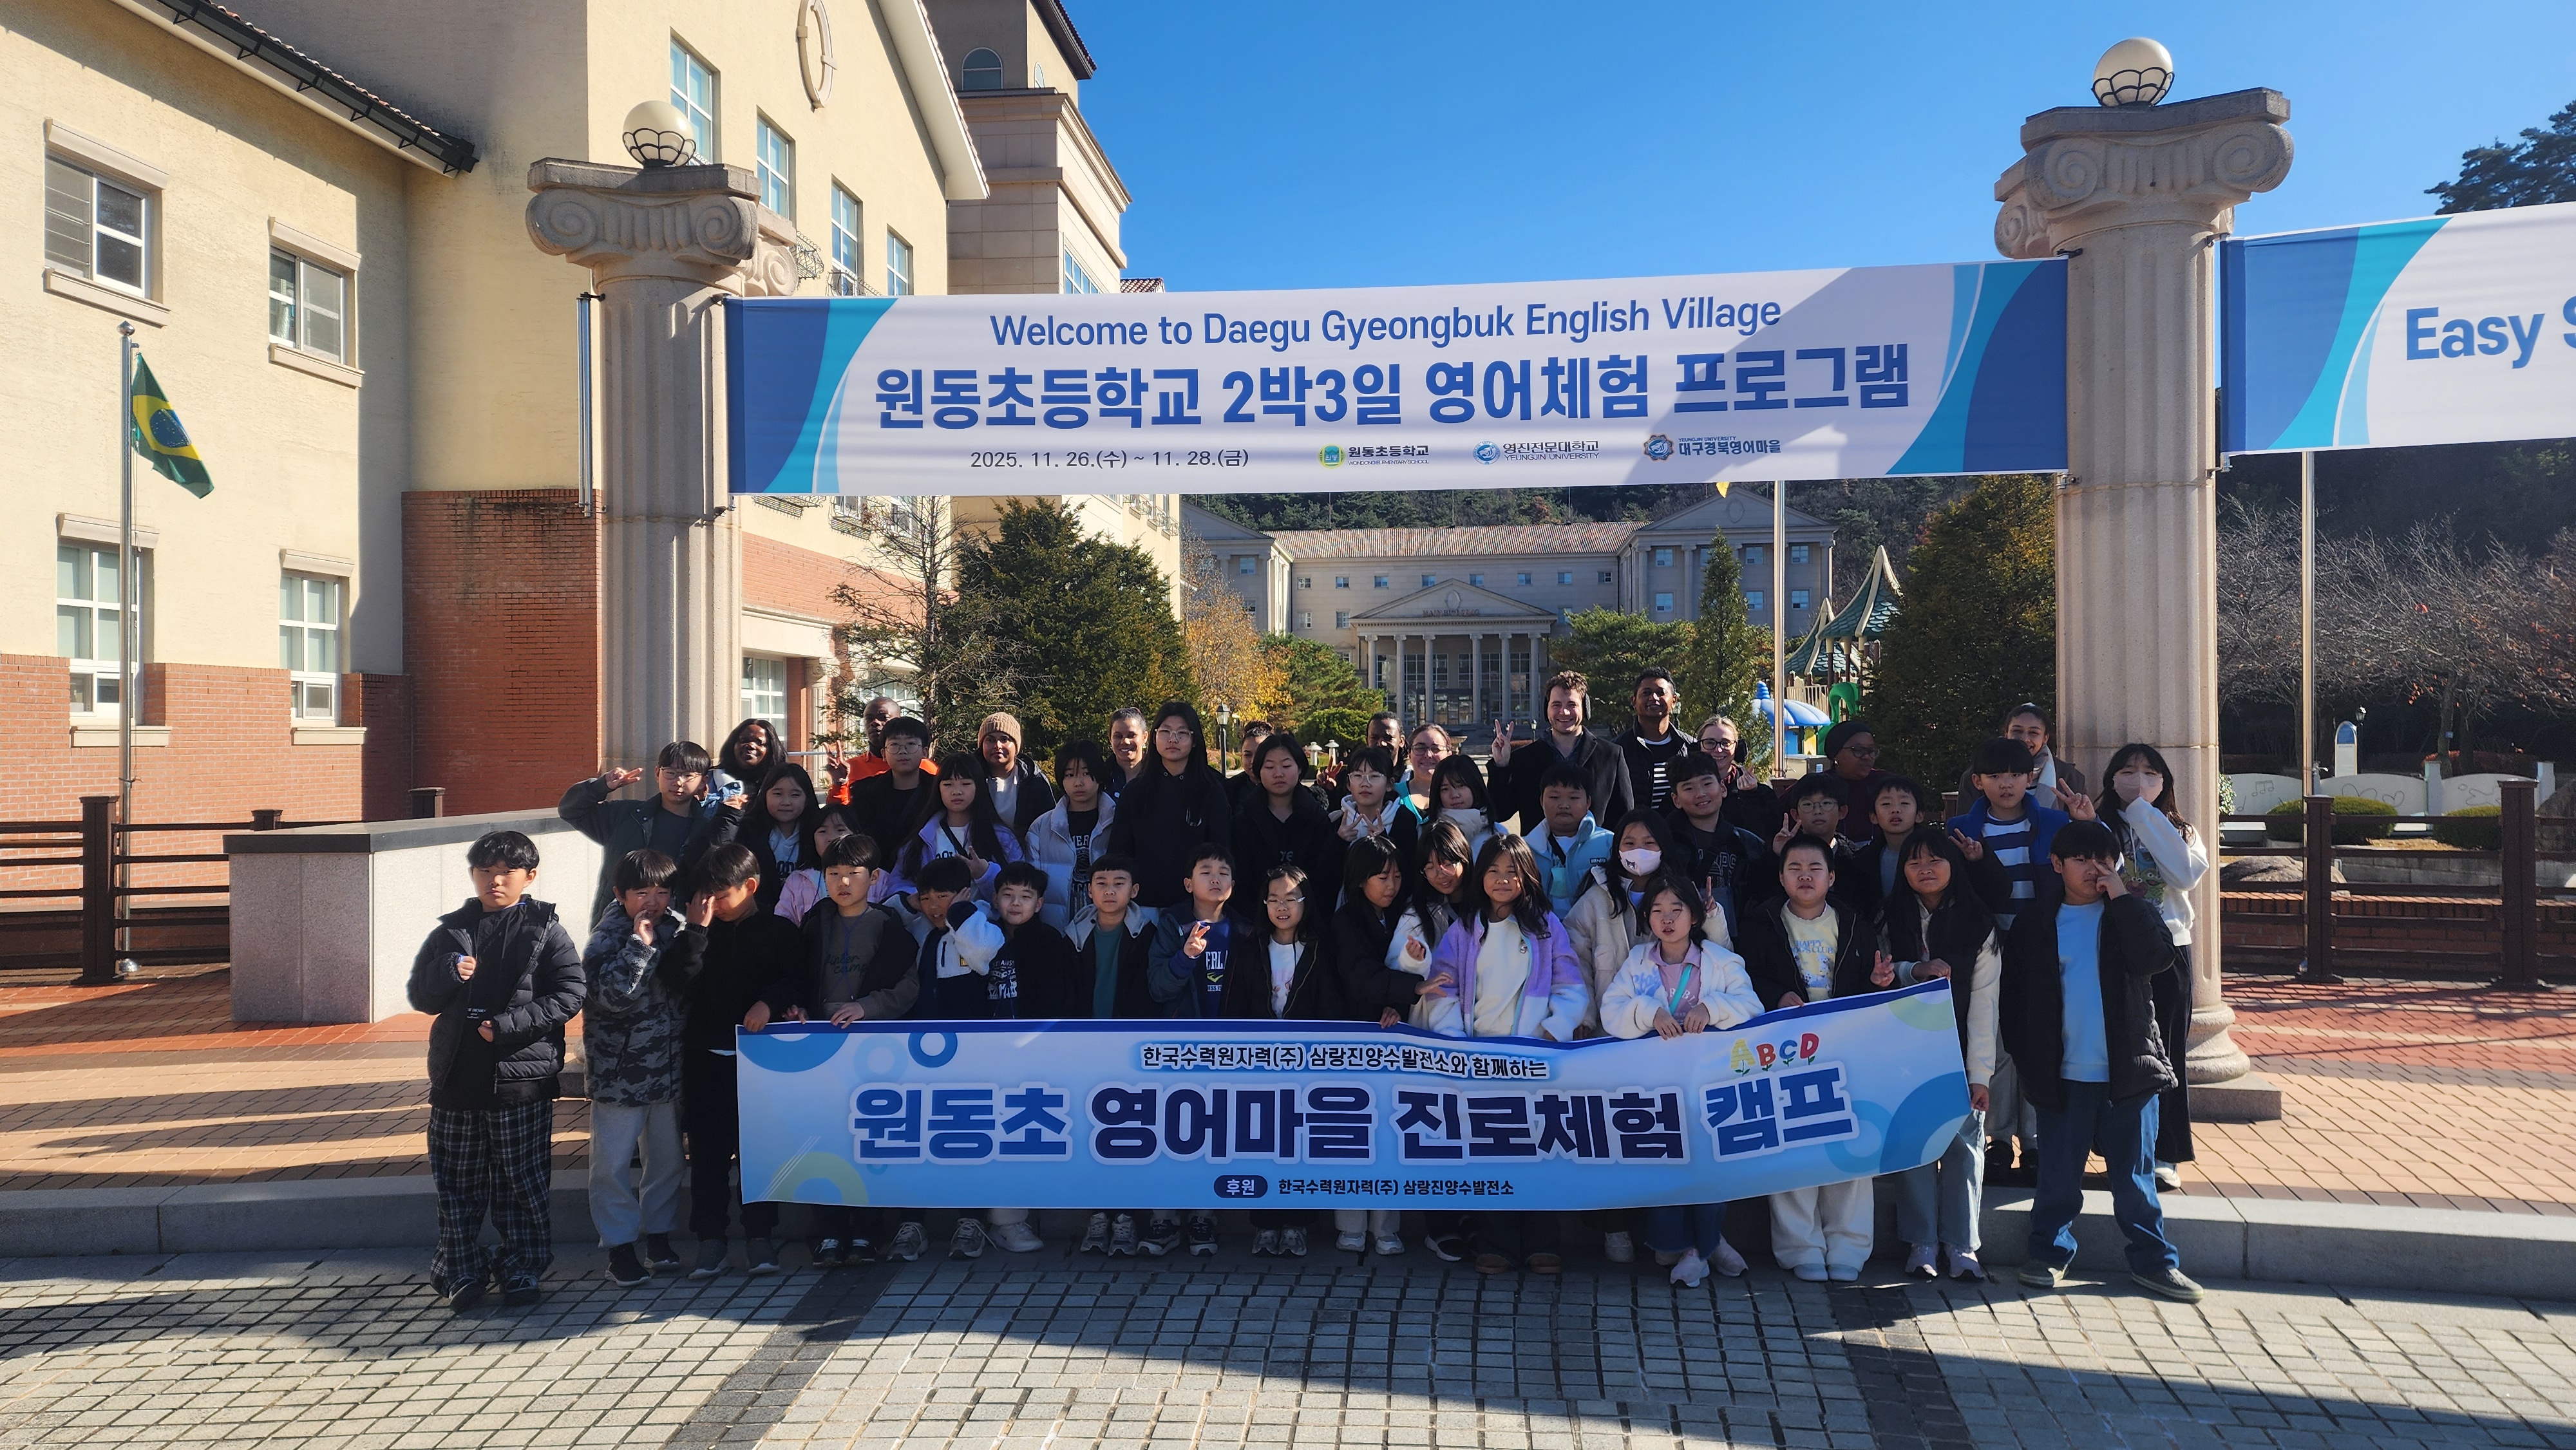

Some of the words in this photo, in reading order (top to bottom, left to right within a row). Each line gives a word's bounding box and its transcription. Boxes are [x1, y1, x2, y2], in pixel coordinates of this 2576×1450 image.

[990, 315, 1148, 346] Welcome
[1159, 316, 1193, 344] to
[1204, 313, 1310, 352] Daegu
[1321, 305, 1515, 350] Gyeongbuk
[1526, 299, 1649, 343] English
[1662, 296, 1782, 337] Village
[2406, 306, 2546, 370] Easy
[875, 366, 1202, 429] 원동초등학교
[1222, 363, 1401, 427] 2박3일
[1425, 354, 1649, 424] 영어체험
[1674, 343, 1909, 411] 프로그램
[971, 451, 1023, 467] 2025.
[1031, 451, 1059, 467] 11.
[1066, 449, 1127, 469] 26.(수)
[1152, 451, 1179, 466] 11.
[1187, 449, 1249, 467] 28.(금)
[1348, 445, 1429, 458] 원동초등학교
[1502, 440, 1599, 454] 영진전문대학교
[1678, 440, 1781, 456] 대구경북영어마을
[1142, 1046, 1304, 1068] 한국수력원자력(주)
[1309, 1046, 1468, 1075] 삼랑진양수발전소와
[1472, 1057, 1547, 1078] 함께하는
[1730, 1033, 1819, 1069] ABCD
[854, 1088, 1068, 1159] 원동초
[1091, 1086, 1373, 1159] 영어마을
[1395, 1091, 1684, 1159] 진로체험
[1705, 1067, 1853, 1156] 캠프
[1226, 1178, 1256, 1196] 후원
[1278, 1178, 1399, 1196] 한국수력원자력(주)
[1403, 1179, 1515, 1196] 삼랑진양수발전소
